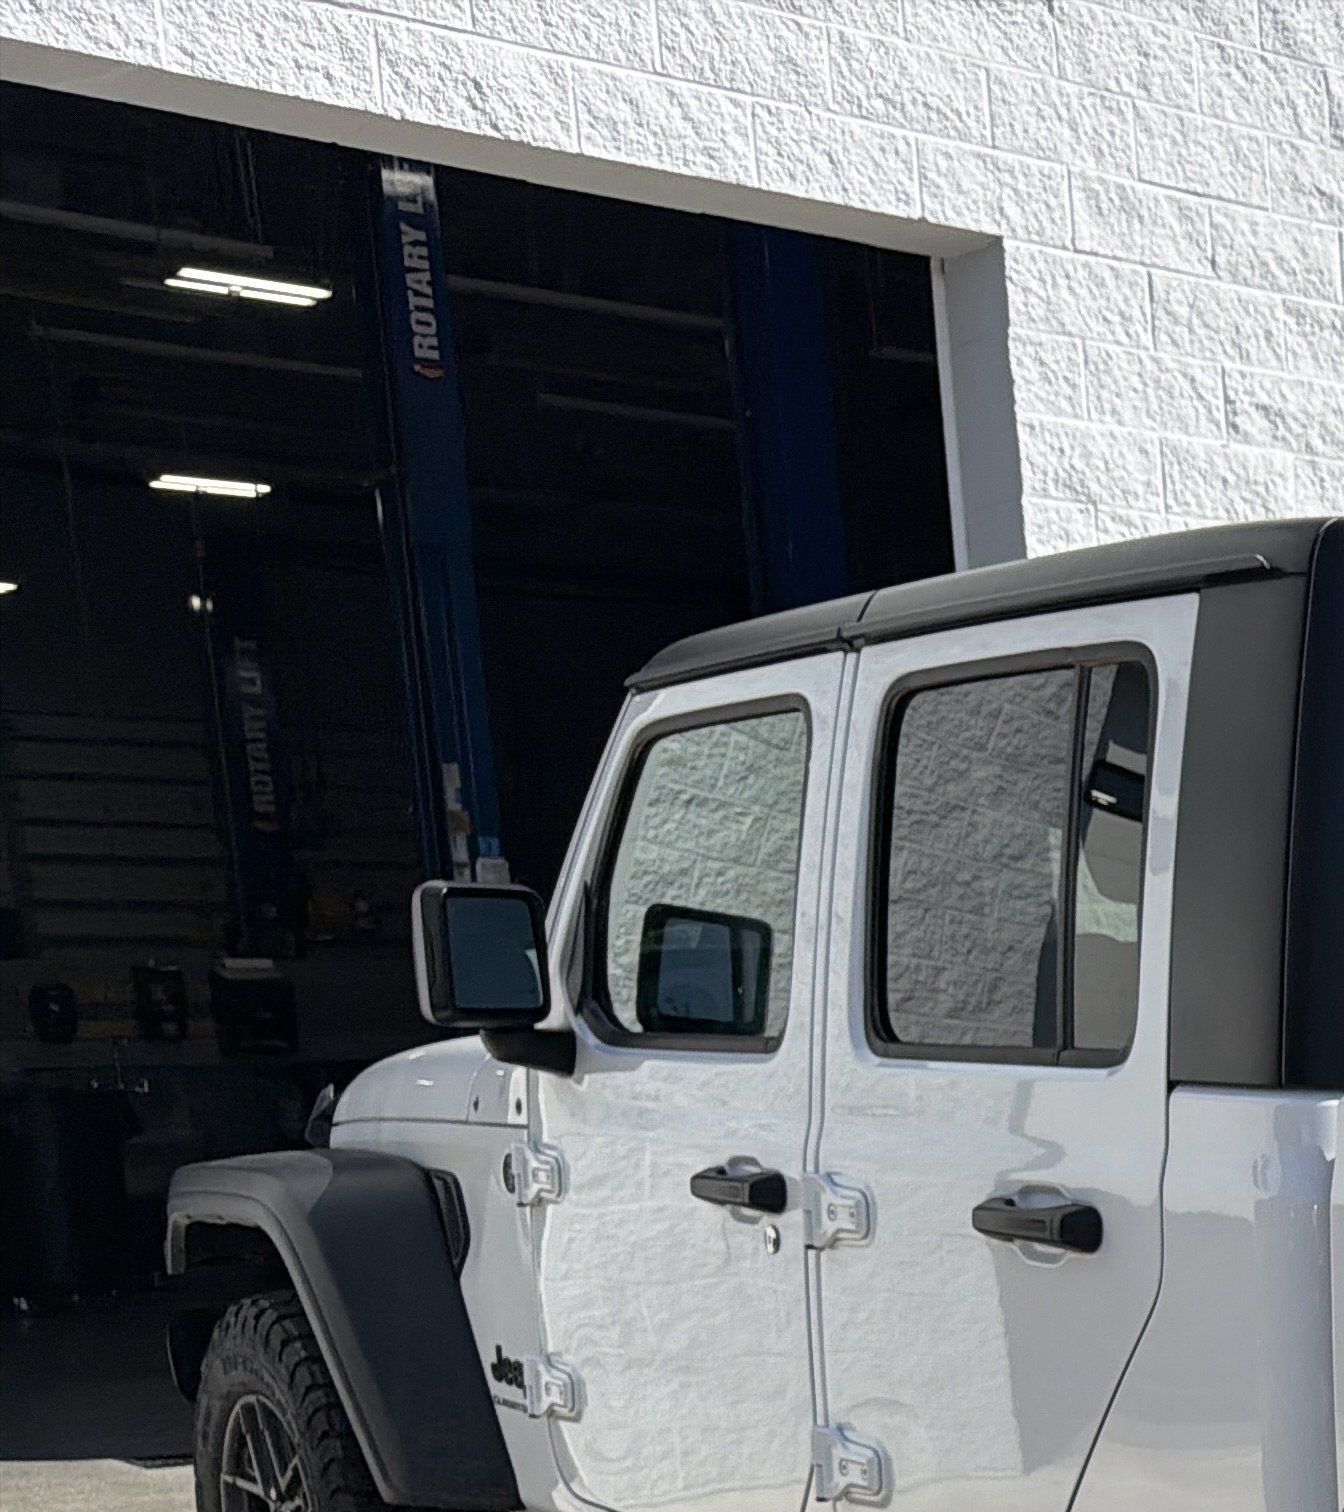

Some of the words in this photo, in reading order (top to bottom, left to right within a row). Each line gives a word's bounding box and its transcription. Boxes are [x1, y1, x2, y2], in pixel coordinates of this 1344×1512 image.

[400, 220, 441, 361] ROTARY
[241, 701, 277, 814] ROTARY
[491, 1344, 527, 1400] Jee
